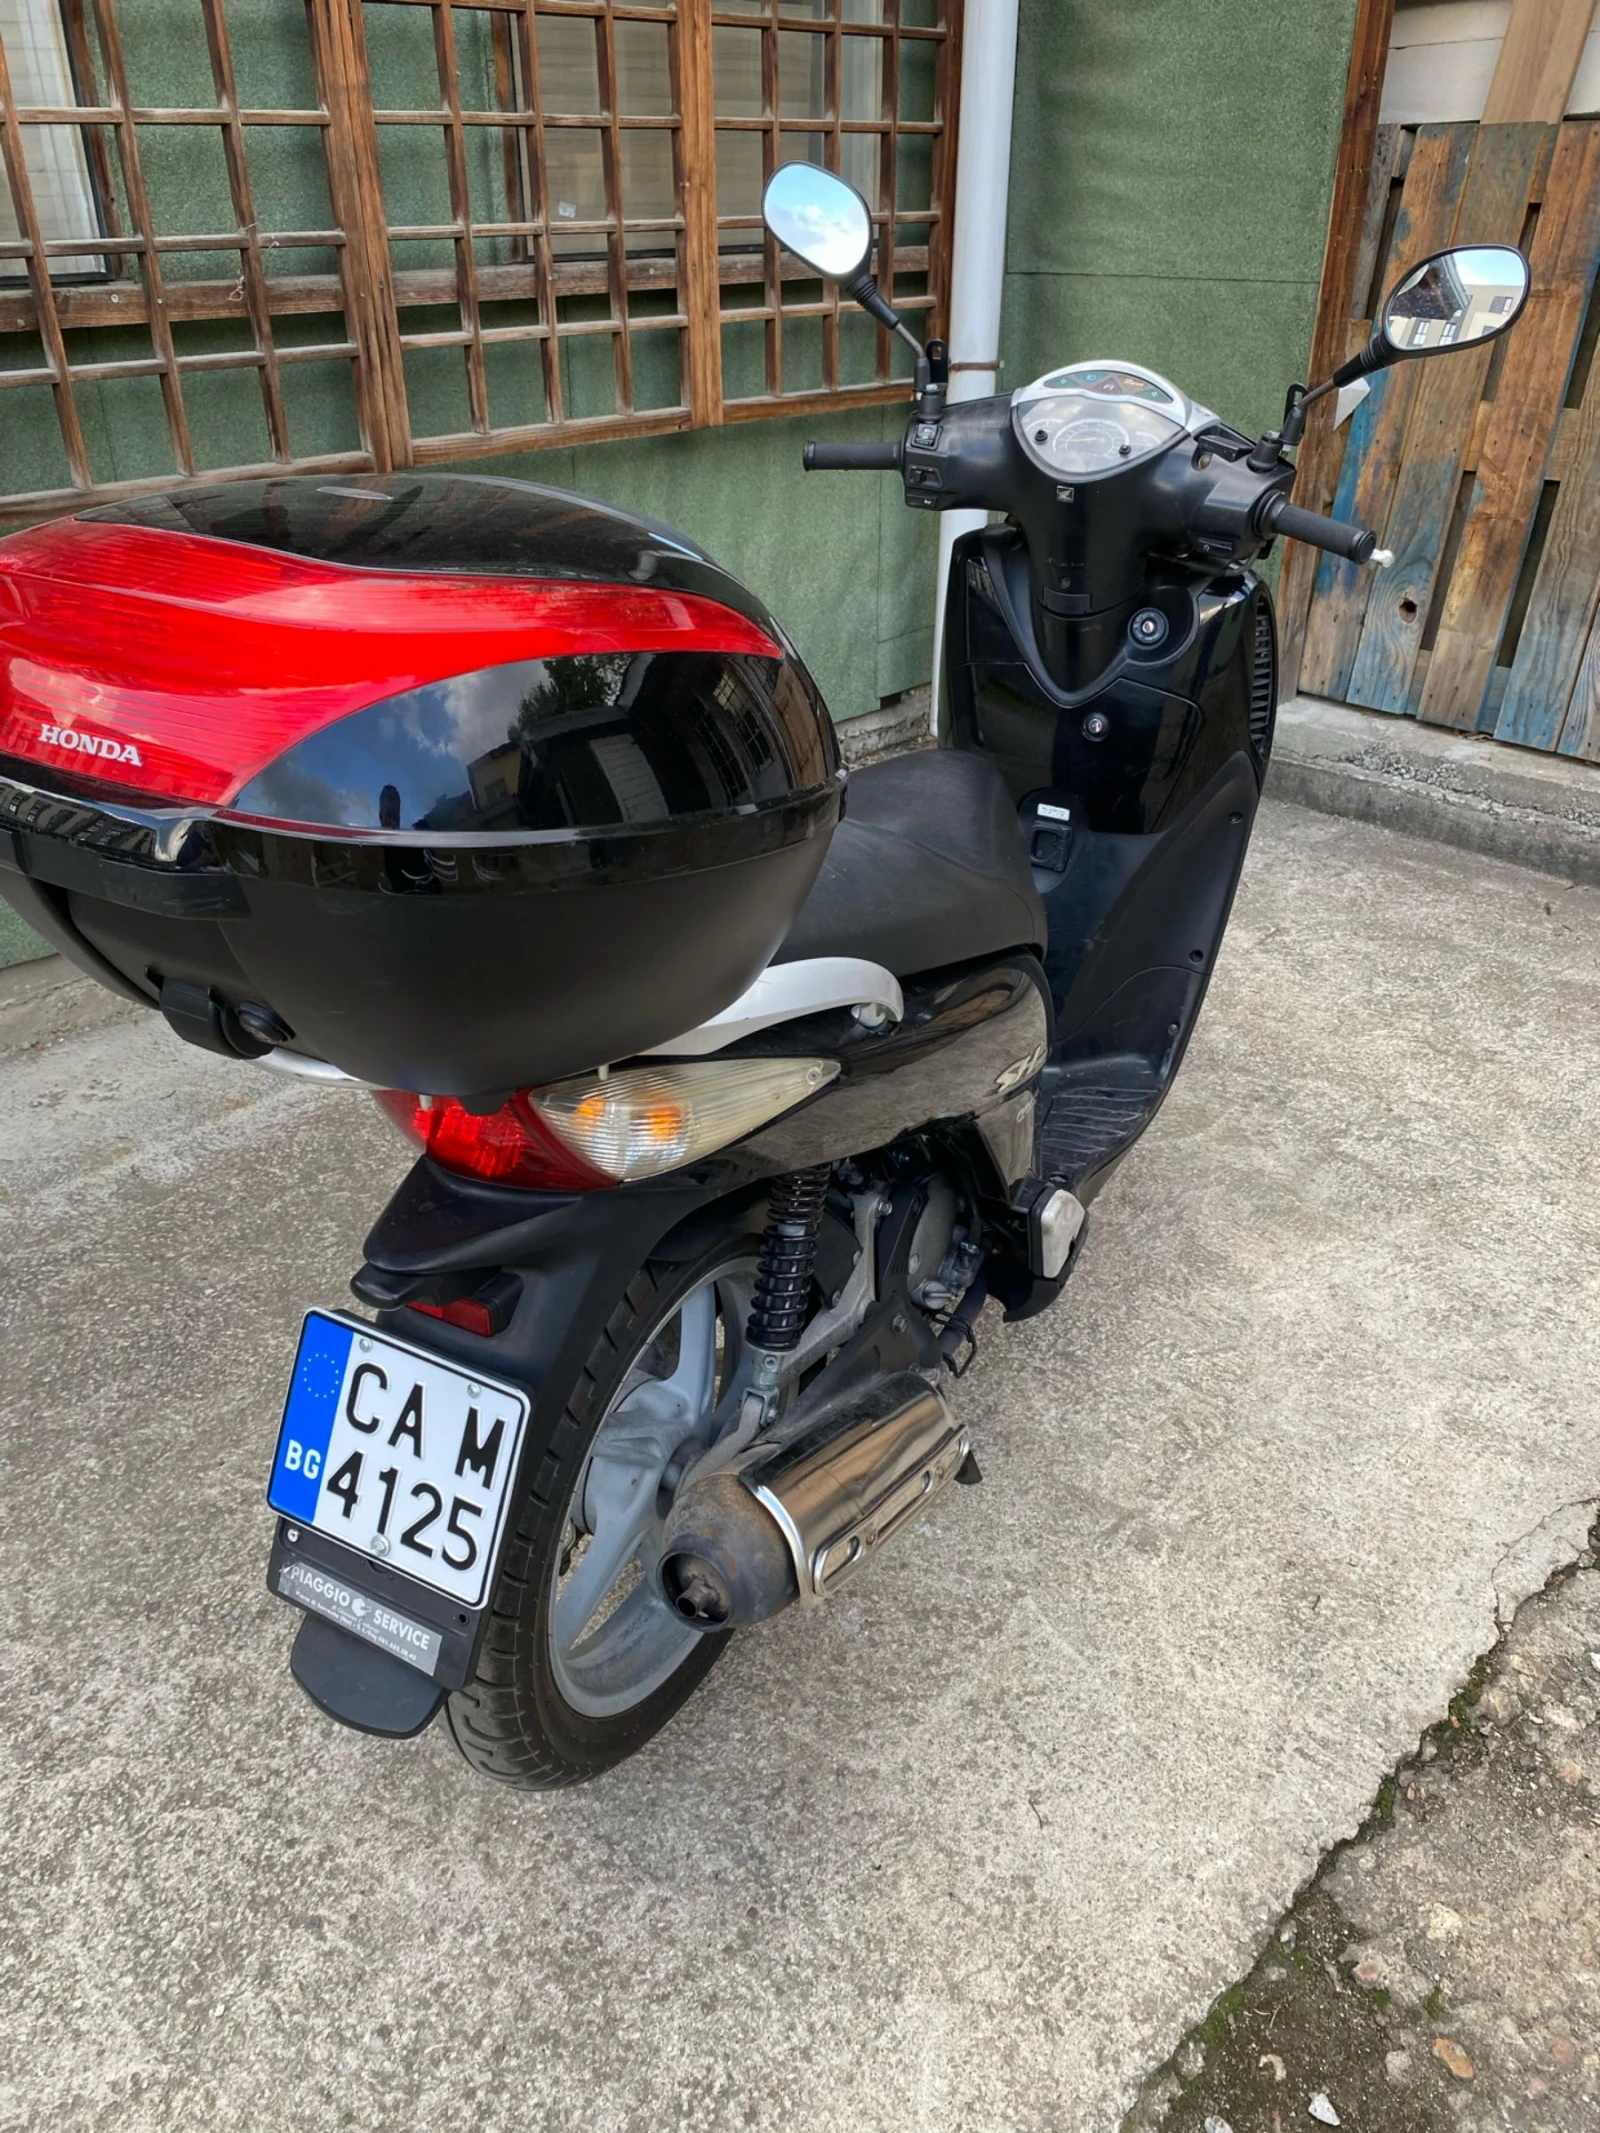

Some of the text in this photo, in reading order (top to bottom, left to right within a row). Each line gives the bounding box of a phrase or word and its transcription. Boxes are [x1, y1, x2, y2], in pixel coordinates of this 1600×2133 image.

[38, 723, 142, 767] HONDA
[284, 1439, 321, 1480] BG
[346, 1362, 506, 1490] CA M
[326, 1450, 483, 1571] 4125
[290, 1565, 351, 1607] PIAGGIO
[372, 1609, 431, 1651] SERVICE
